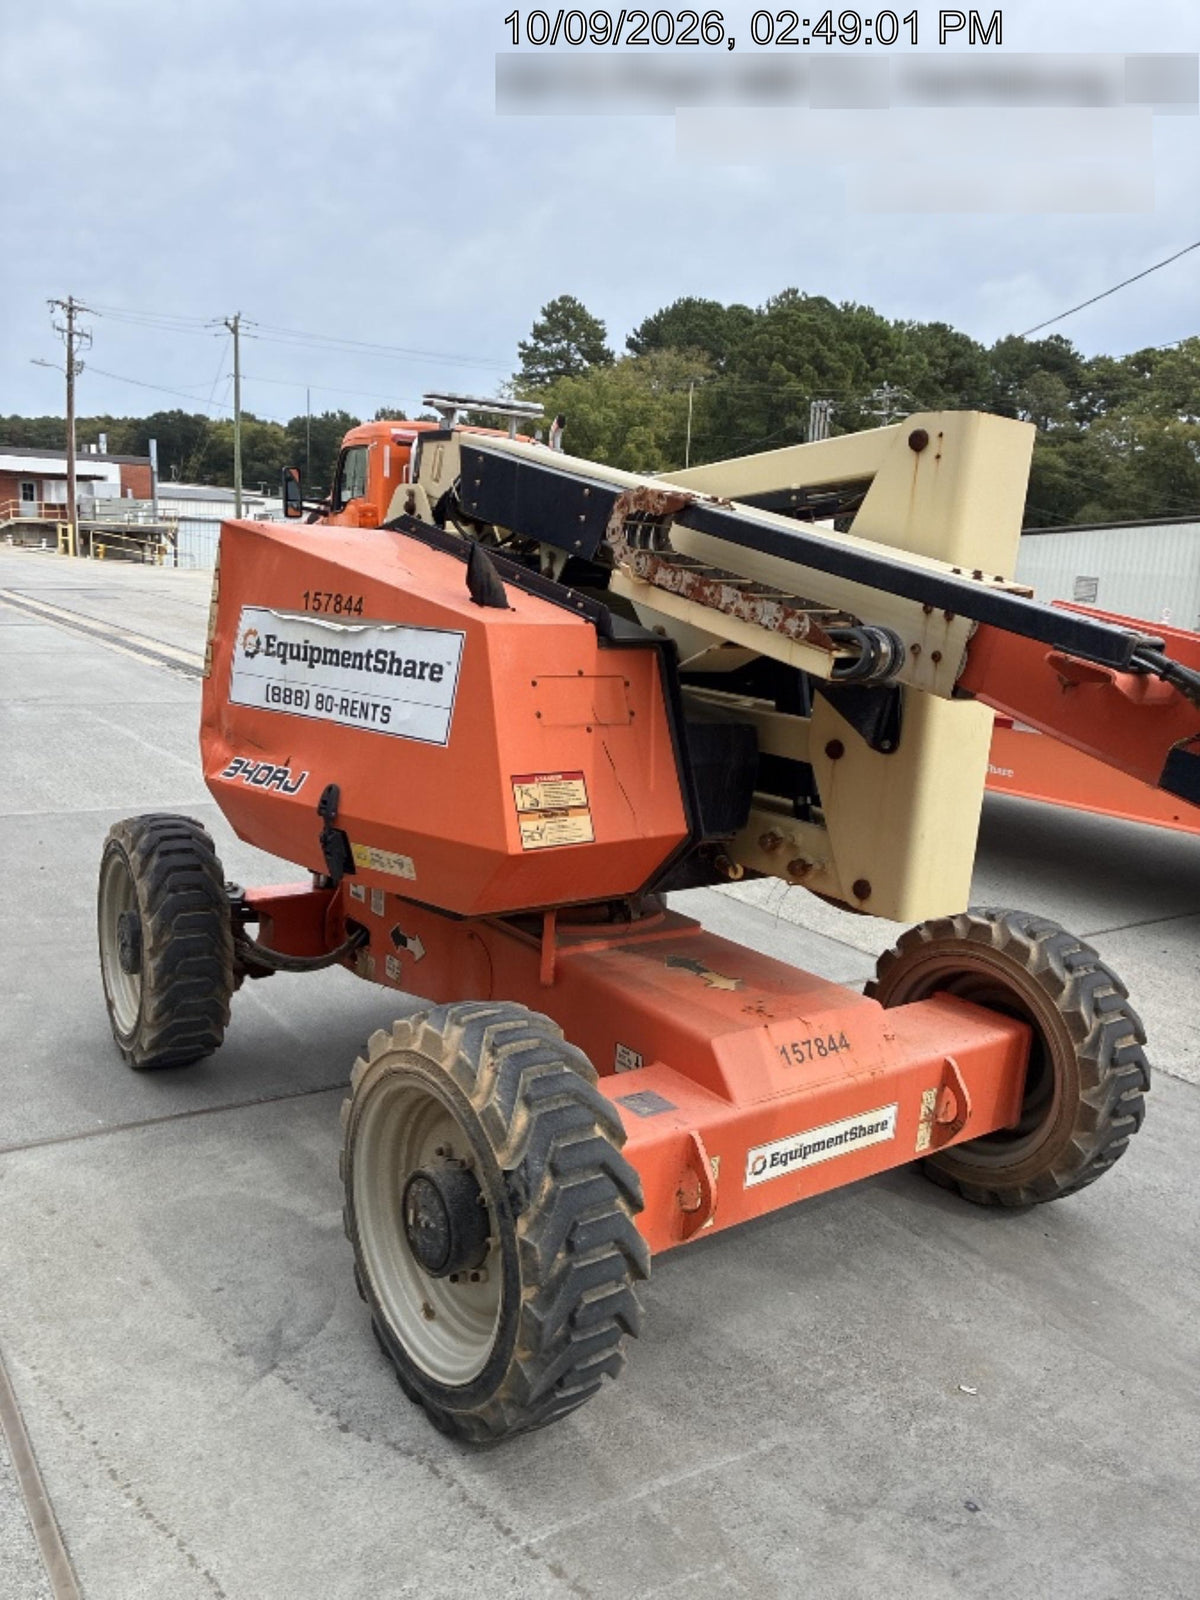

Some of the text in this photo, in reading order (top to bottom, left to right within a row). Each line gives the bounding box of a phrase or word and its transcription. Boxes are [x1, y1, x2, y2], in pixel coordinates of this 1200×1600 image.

[303, 590, 364, 616] 157844
[264, 633, 444, 683] EquipmentShare
[265, 683, 392, 725] (888) 80-RENTS
[221, 758, 307, 793] 340AJ
[780, 1032, 850, 1066] 157844
[769, 1119, 889, 1169] EquipmentShare
